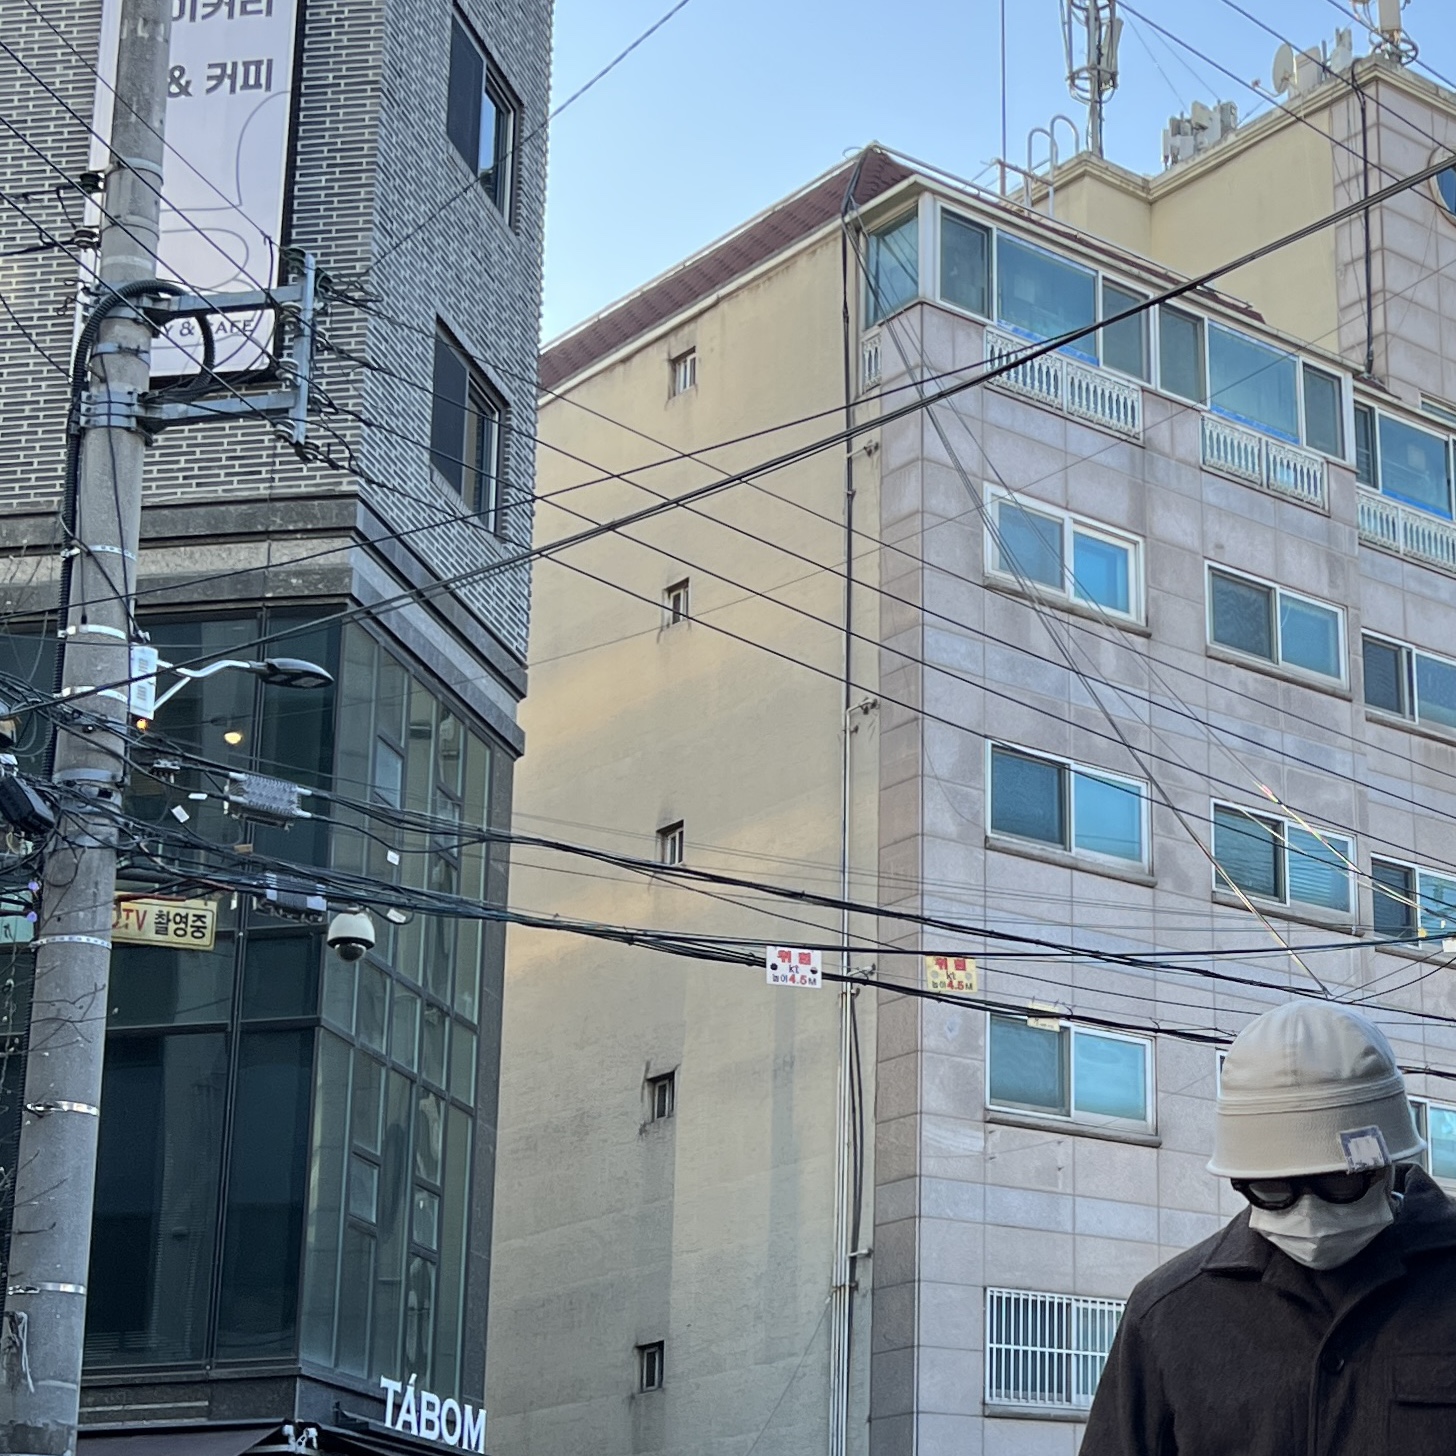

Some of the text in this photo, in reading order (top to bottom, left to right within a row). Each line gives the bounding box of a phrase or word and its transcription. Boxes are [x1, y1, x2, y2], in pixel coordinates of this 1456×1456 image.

[168, 58, 274, 98] & 커피
[179, 321, 195, 337] &
[154, 909, 207, 940] 촬영중
[777, 949, 812, 965] 위험
[788, 964, 800, 974] kt
[945, 970, 957, 980] kt
[380, 1373, 487, 1455] TÁBOM
